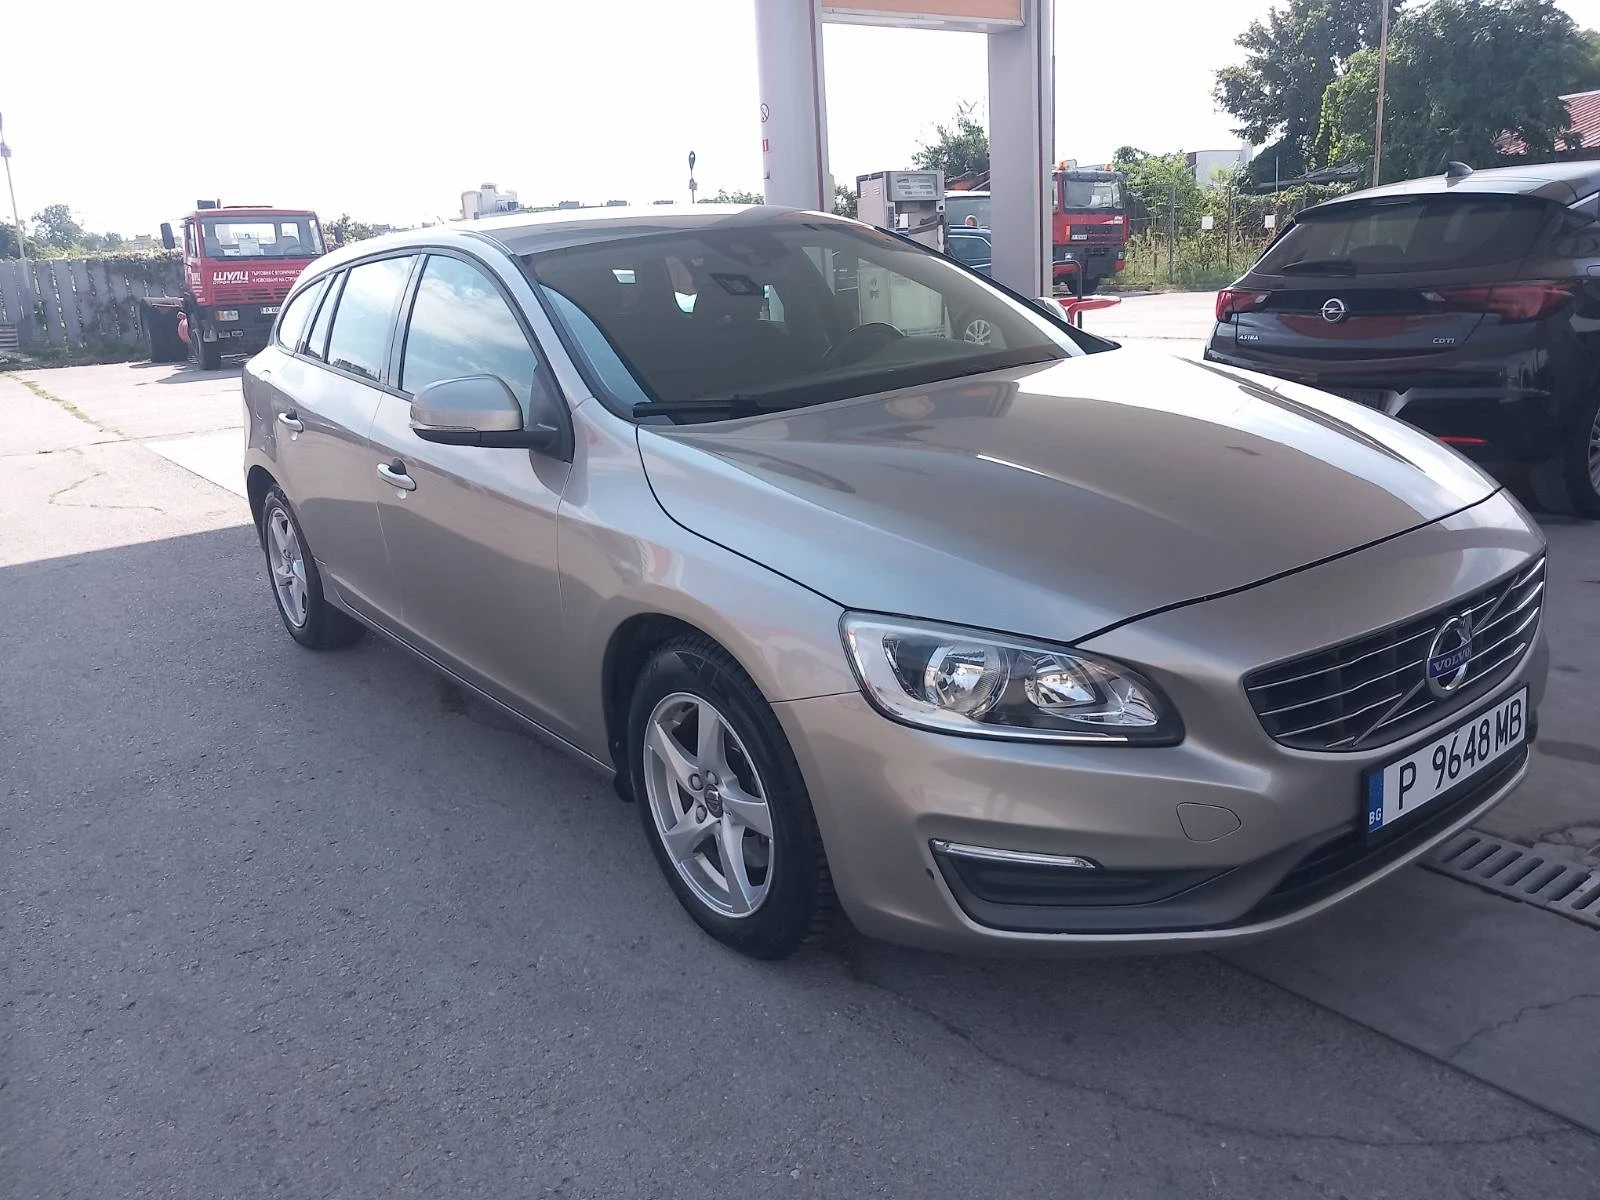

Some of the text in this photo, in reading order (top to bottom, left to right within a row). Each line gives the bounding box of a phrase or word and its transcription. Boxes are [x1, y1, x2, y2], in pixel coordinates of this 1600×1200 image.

[213, 271, 249, 281] ШУЛЦ
[1433, 647, 1471, 672] VOLVO
[1398, 698, 1522, 810] P 9648 MB
[1368, 807, 1382, 825] BG
